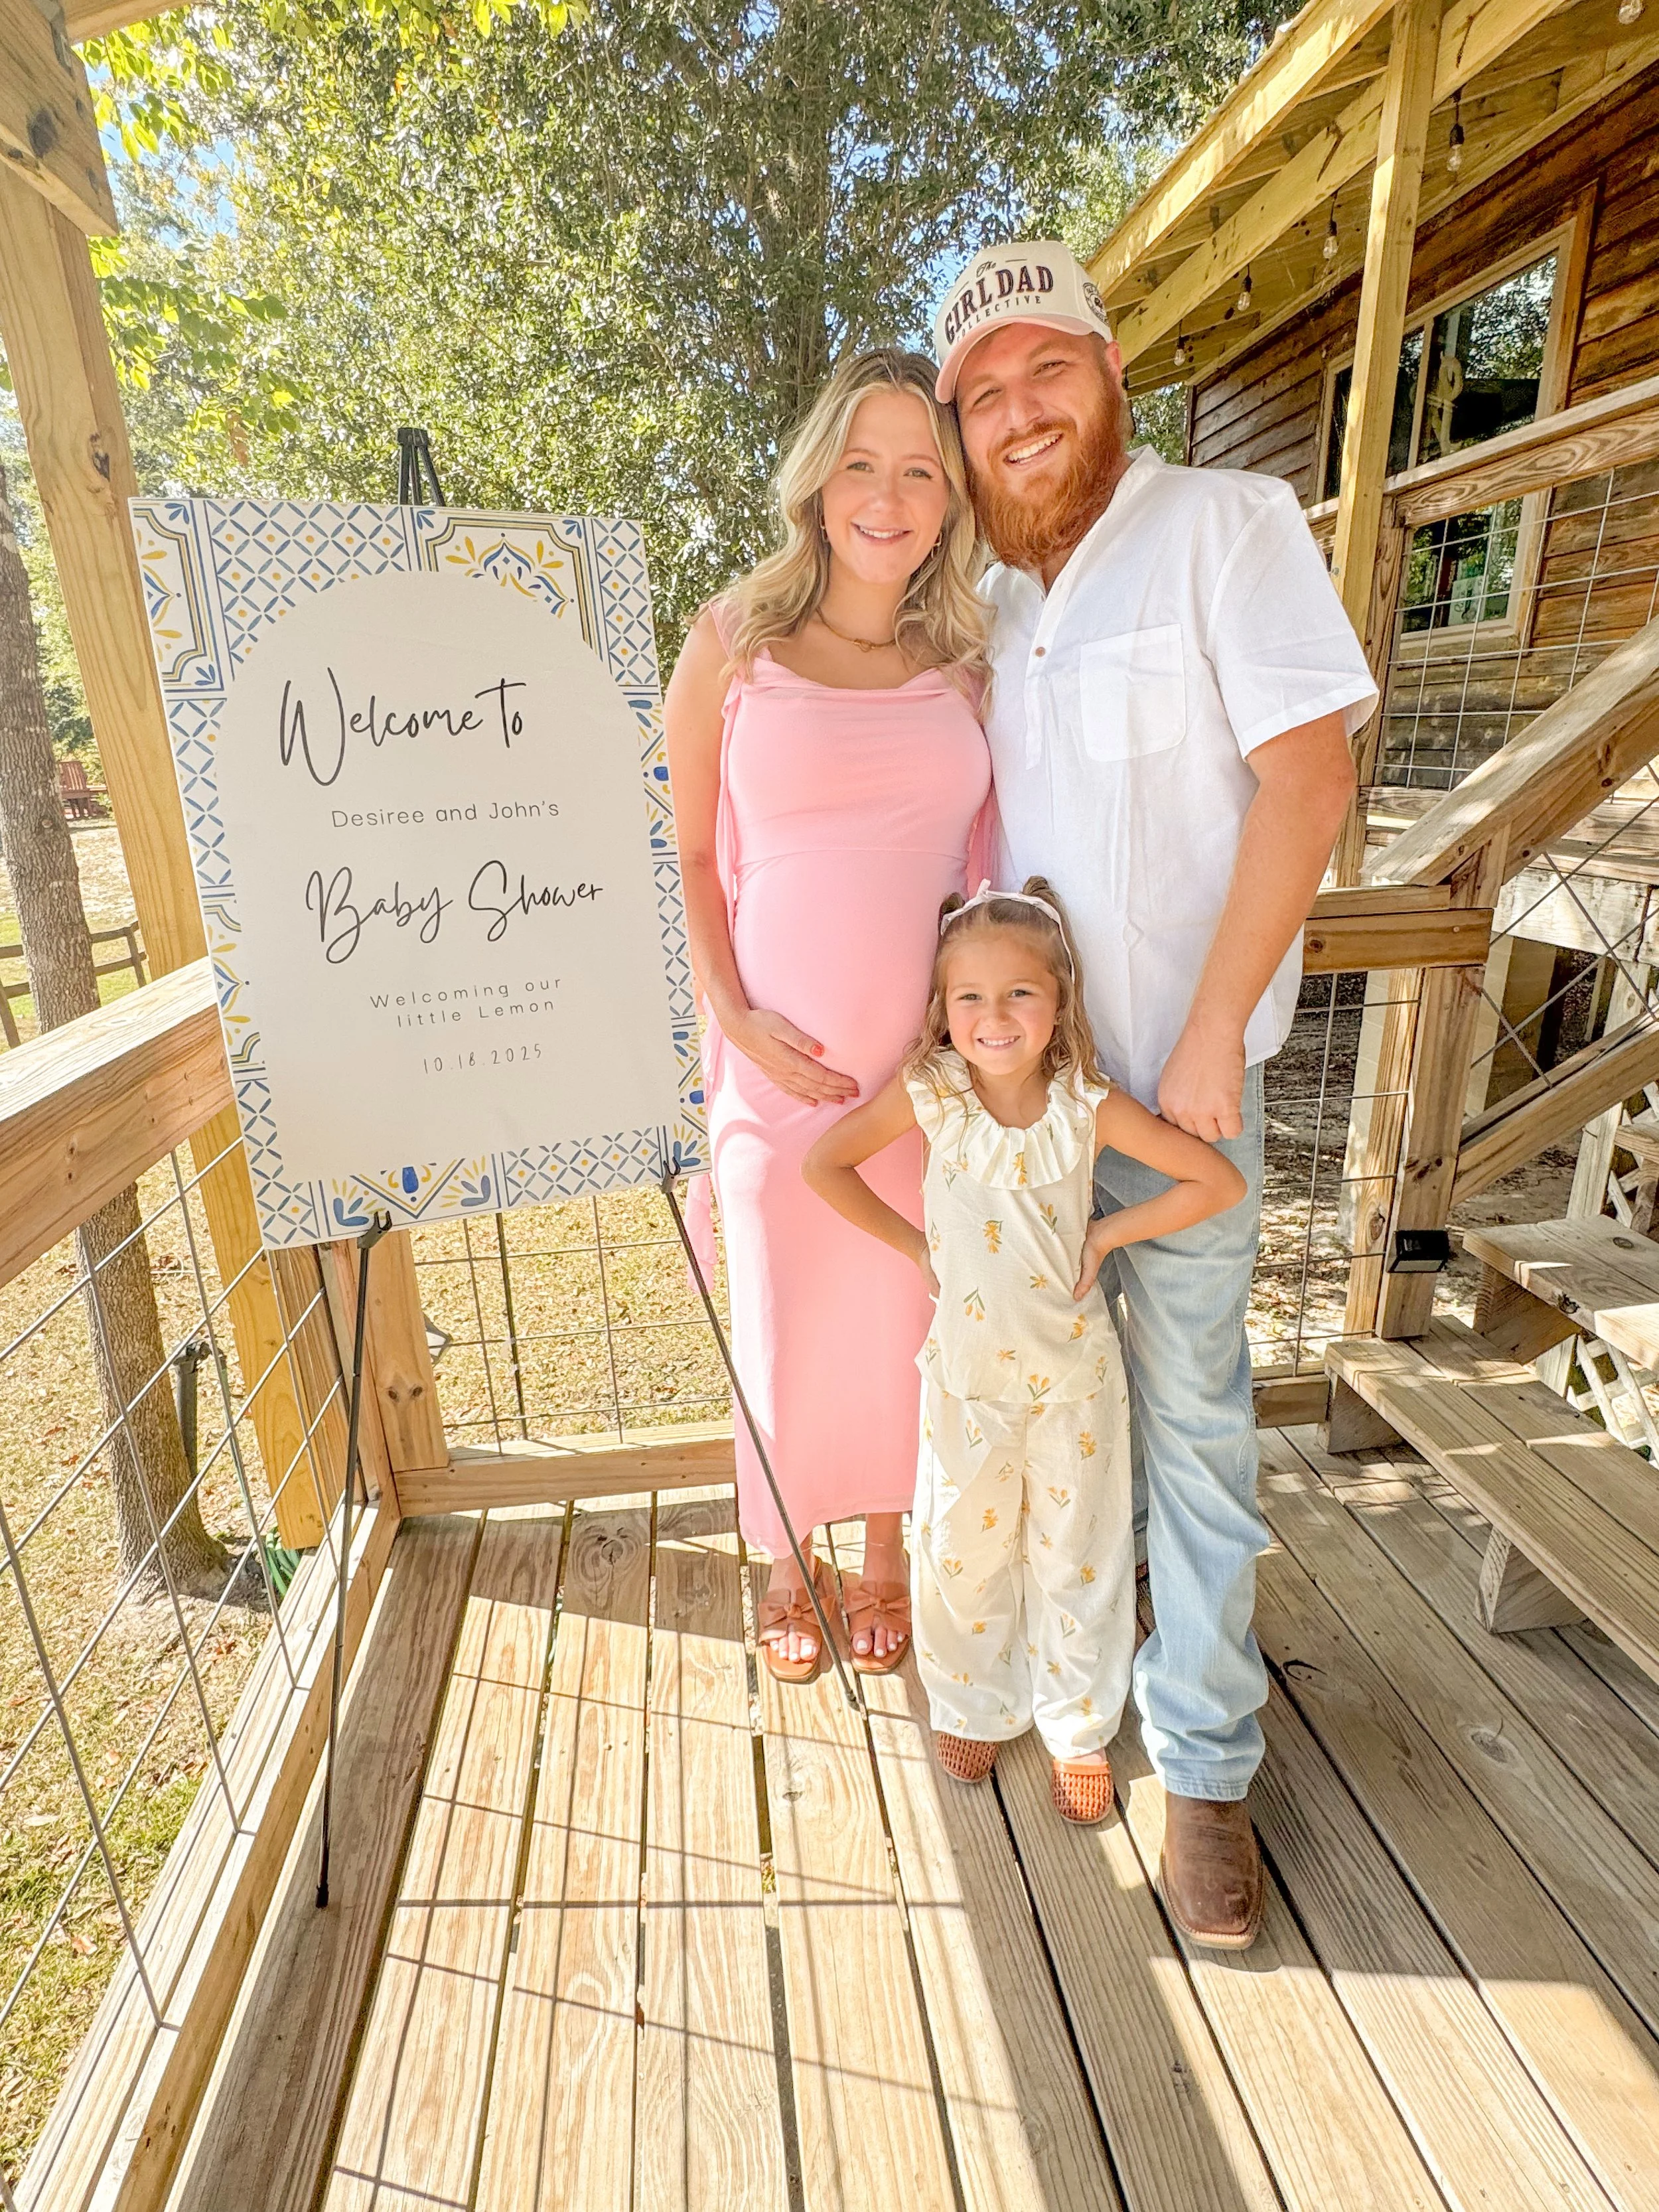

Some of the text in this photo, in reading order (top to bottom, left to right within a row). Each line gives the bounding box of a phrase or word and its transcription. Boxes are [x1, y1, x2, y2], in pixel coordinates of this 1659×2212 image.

[976, 261, 997, 278] The
[944, 265, 1054, 345] GIRL DAD
[279, 666, 484, 786] Welcome
[331, 800, 559, 828] Desiree and John's
[305, 859, 604, 964] Baby Shower
[370, 979, 561, 1009] Welcoming our
[397, 1000, 553, 1028] little Lemon
[423, 1043, 541, 1074] 10.18.2025
